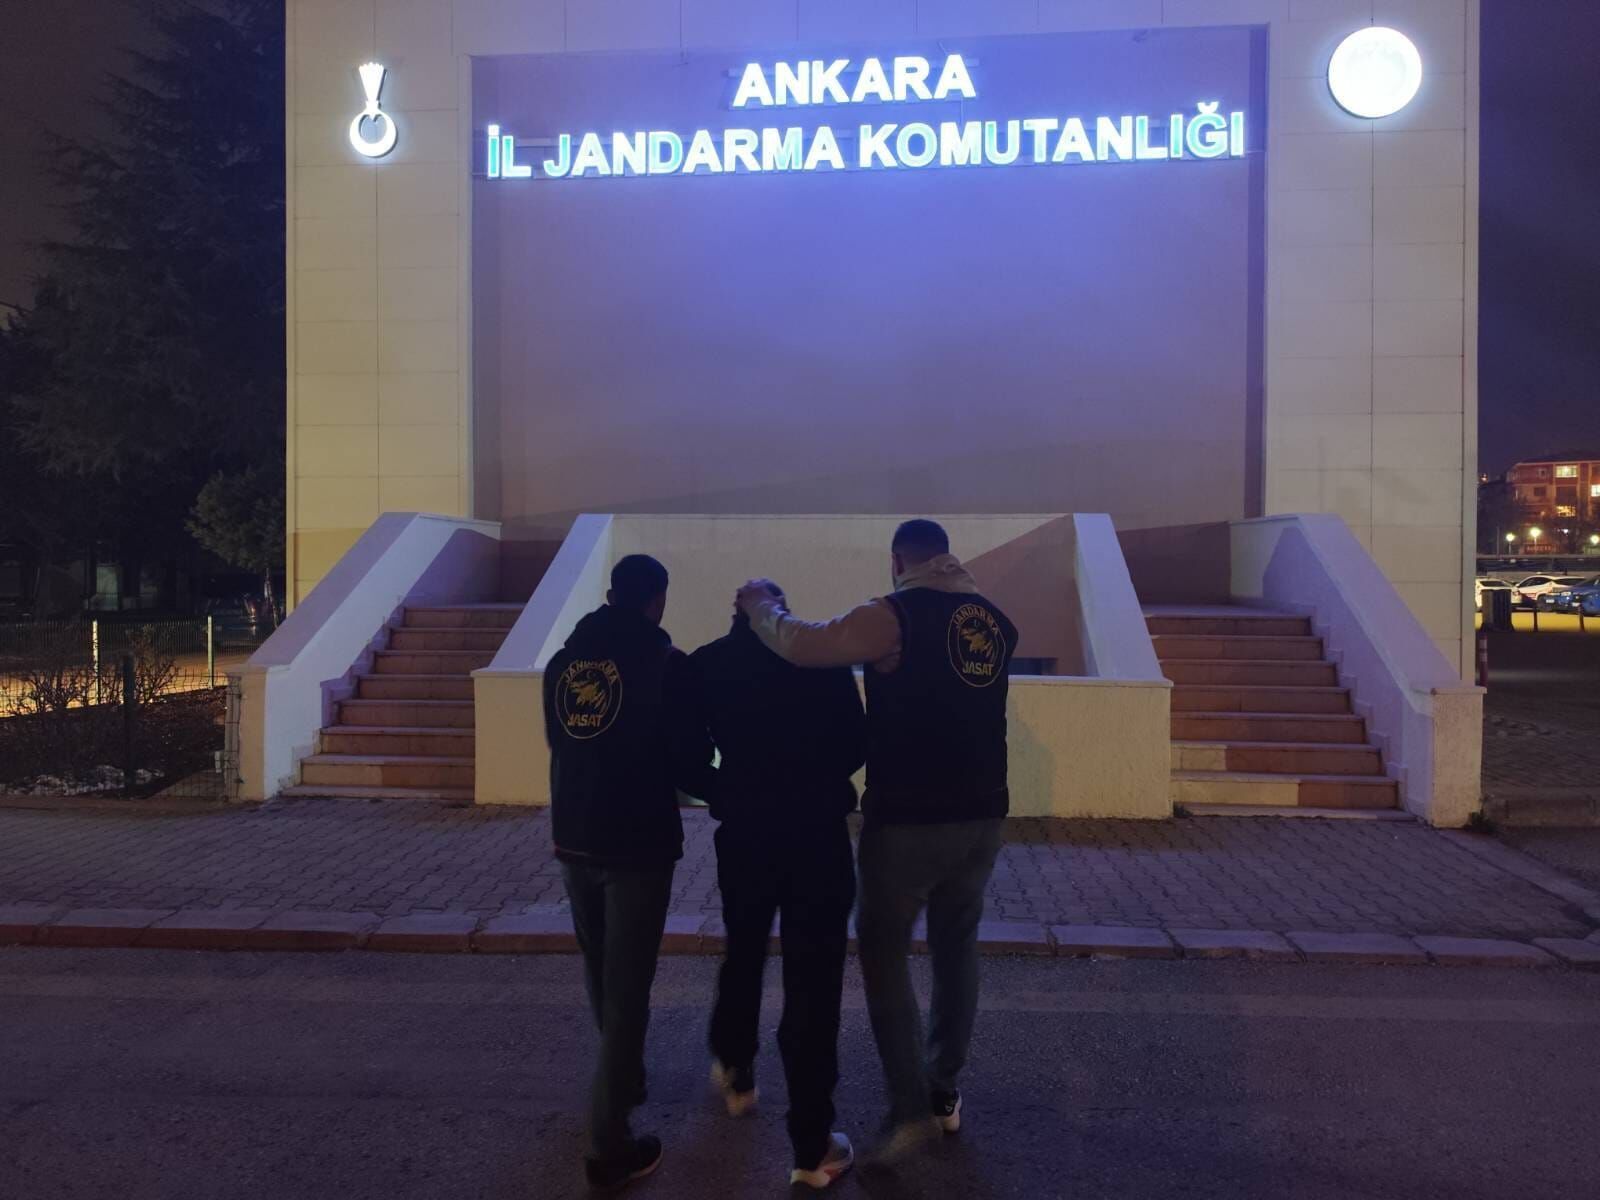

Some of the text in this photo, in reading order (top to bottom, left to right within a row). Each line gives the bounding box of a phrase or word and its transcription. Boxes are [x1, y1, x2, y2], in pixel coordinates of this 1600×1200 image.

[732, 54, 978, 108] ANKARA
[486, 101, 1246, 180] İL JANDARMA KOMUTANLIĞI
[962, 661, 995, 676] JASAT
[567, 713, 604, 727] JASAT
